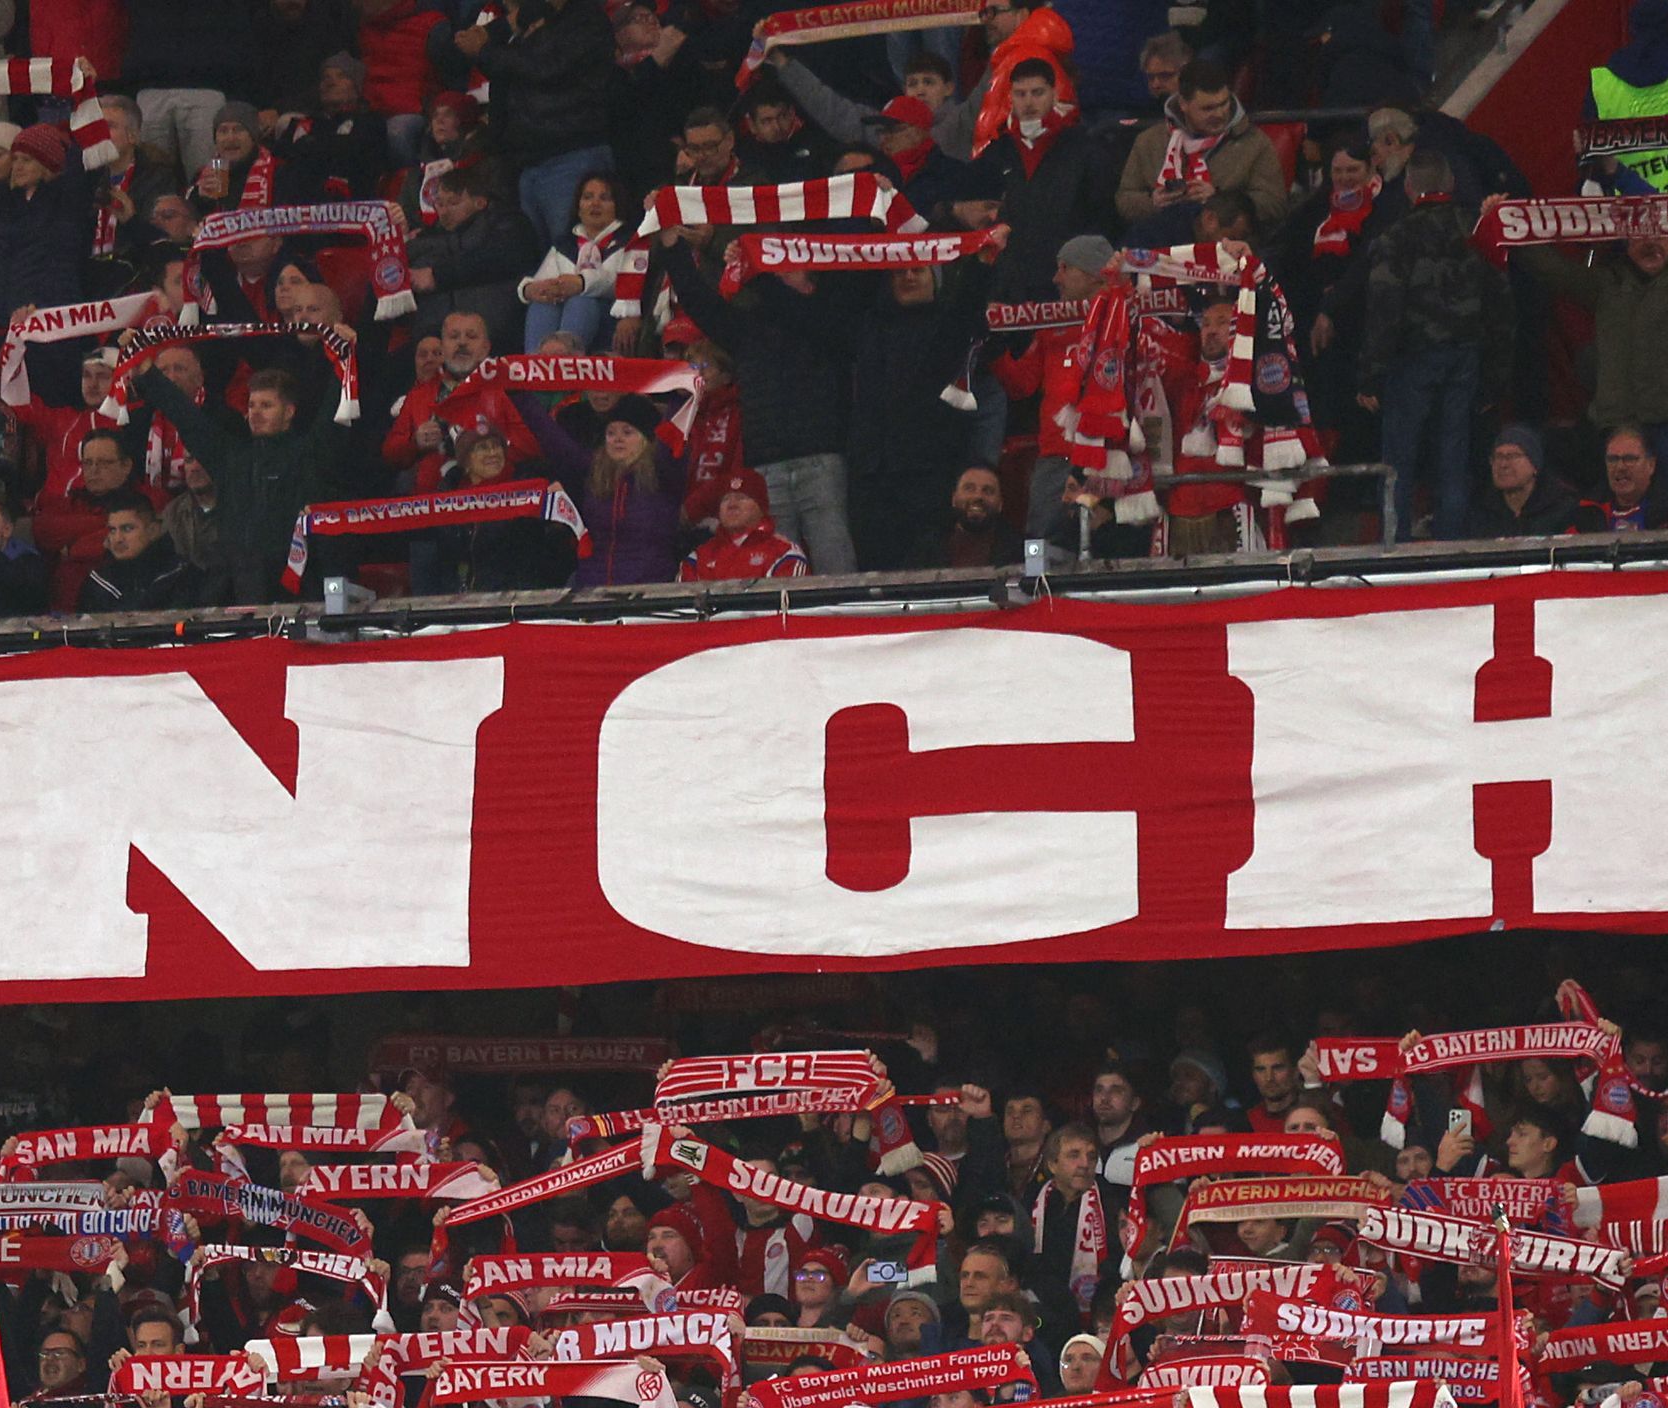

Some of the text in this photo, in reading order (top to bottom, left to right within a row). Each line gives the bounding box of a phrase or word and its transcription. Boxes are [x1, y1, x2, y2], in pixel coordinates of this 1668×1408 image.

[507, 358, 615, 384] BAYERN
[346, 498, 428, 525] BAYERN
[432, 488, 543, 518] MÜNCHEN
[1403, 1029, 1519, 1071] FC BAYERN
[722, 1052, 814, 1088] FCB
[15, 1127, 152, 1166] SAN MIA
[1139, 1143, 1225, 1172] BAYERN
[728, 1159, 932, 1233] SÜDKURVE
[1277, 1303, 1487, 1348] SÜDKURVE
[772, 1347, 1013, 1395] FC Bayern München Fanclub
[972, 1364, 1009, 1380] 1990
